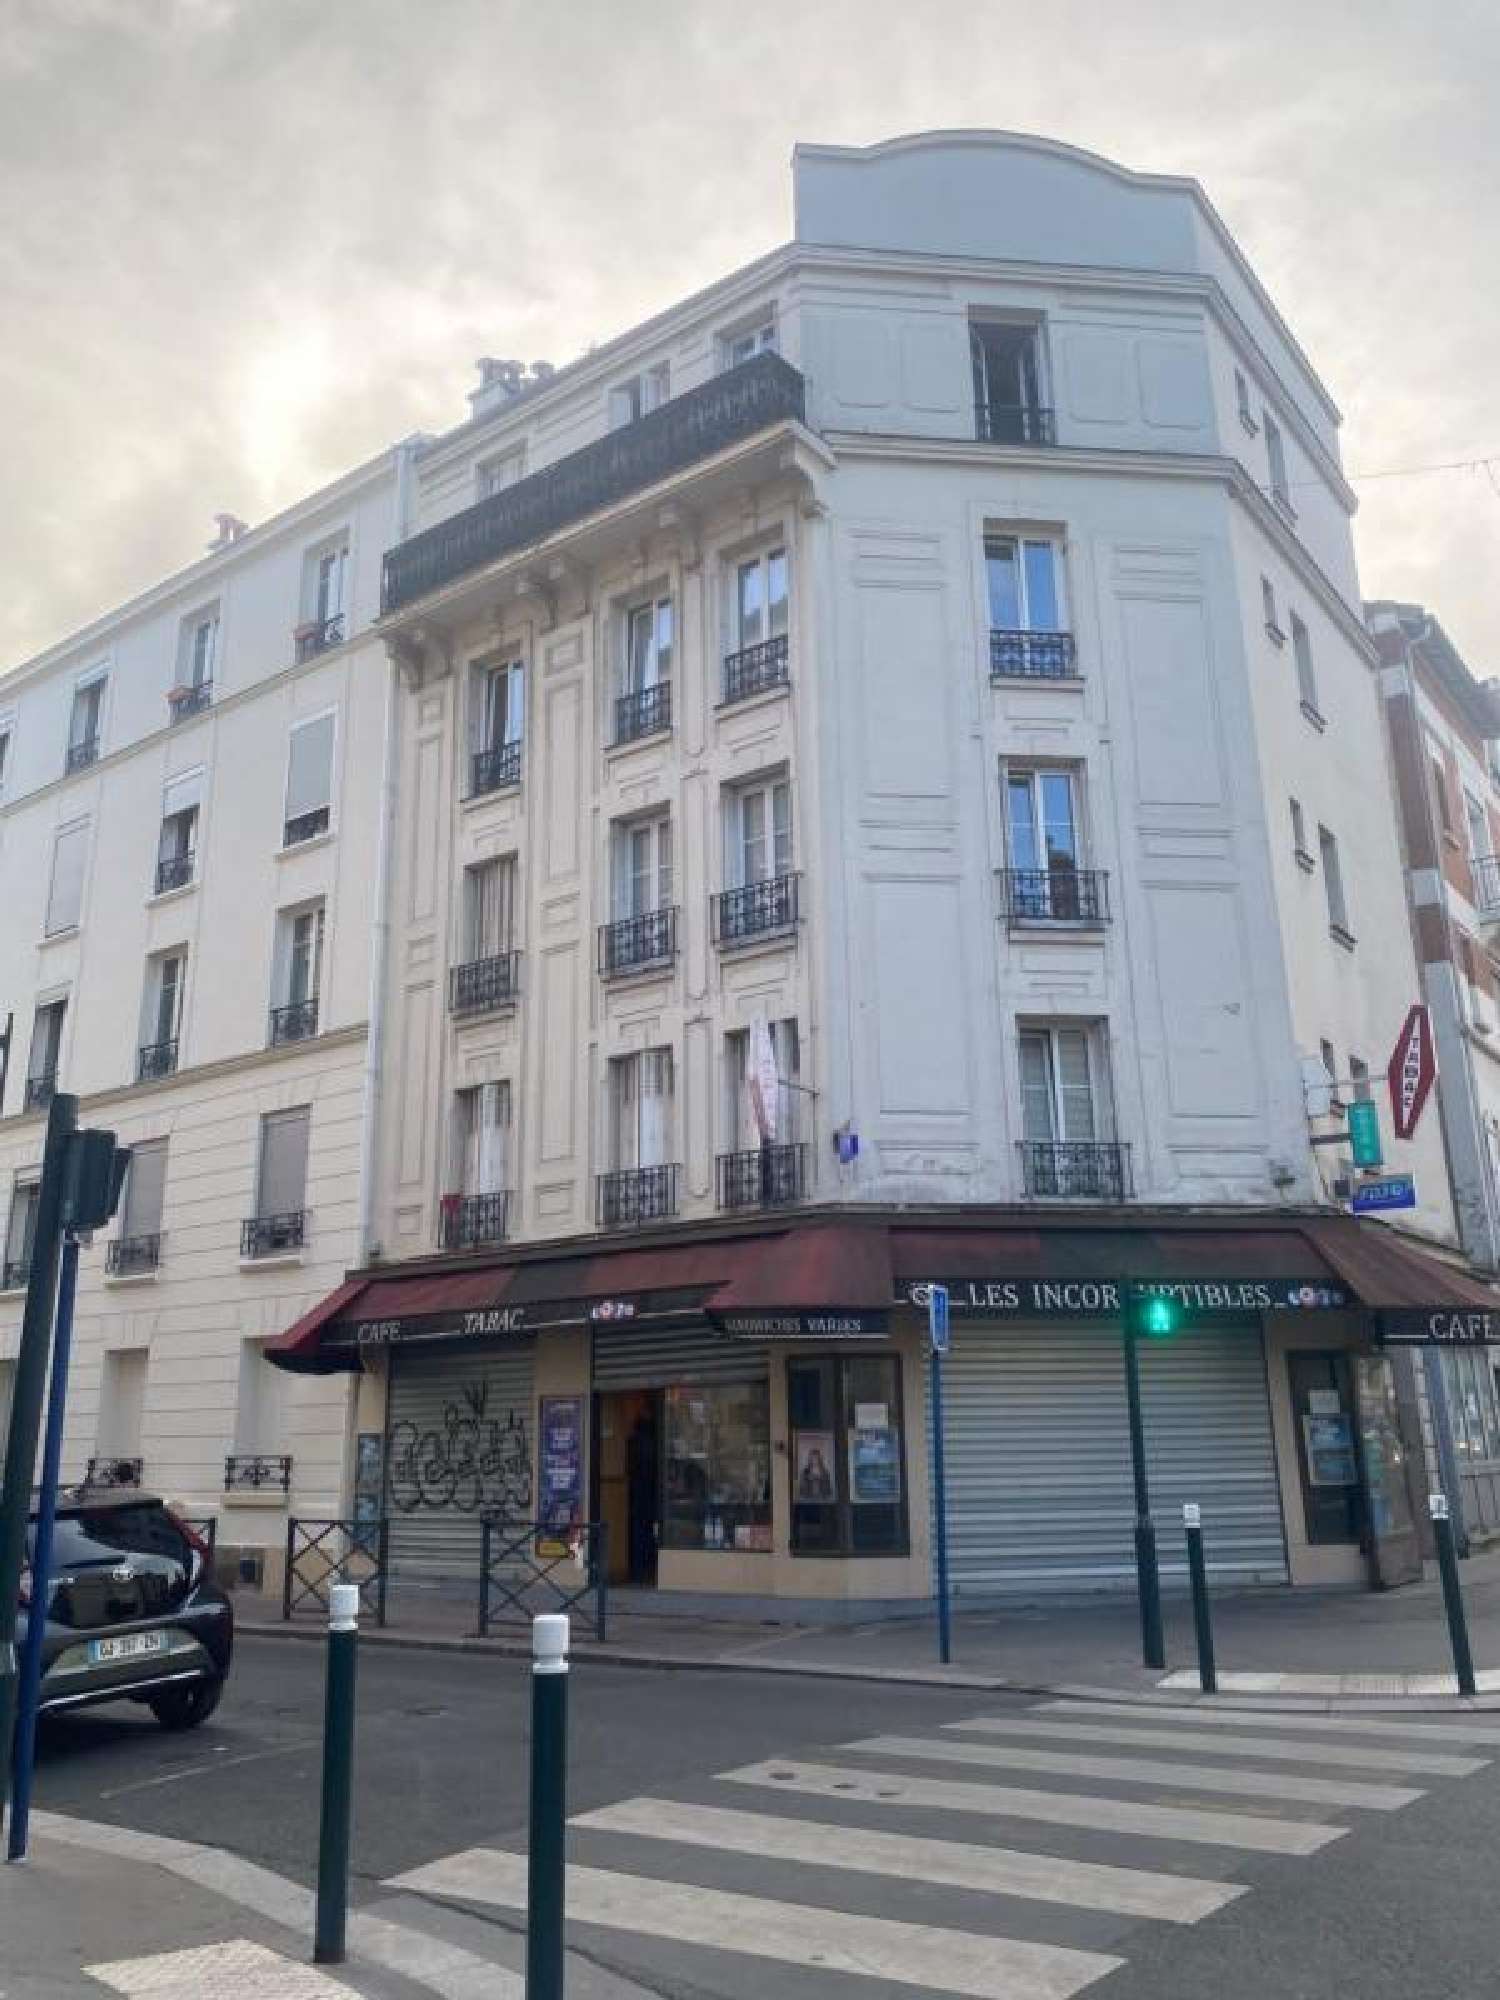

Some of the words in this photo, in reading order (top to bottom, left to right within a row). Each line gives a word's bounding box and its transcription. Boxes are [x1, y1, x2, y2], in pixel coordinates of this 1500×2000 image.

[969, 1284, 1019, 1306] LES
[1033, 1284, 1271, 1309] INCORPTIBLES
[464, 1308, 524, 1335] TABAC
